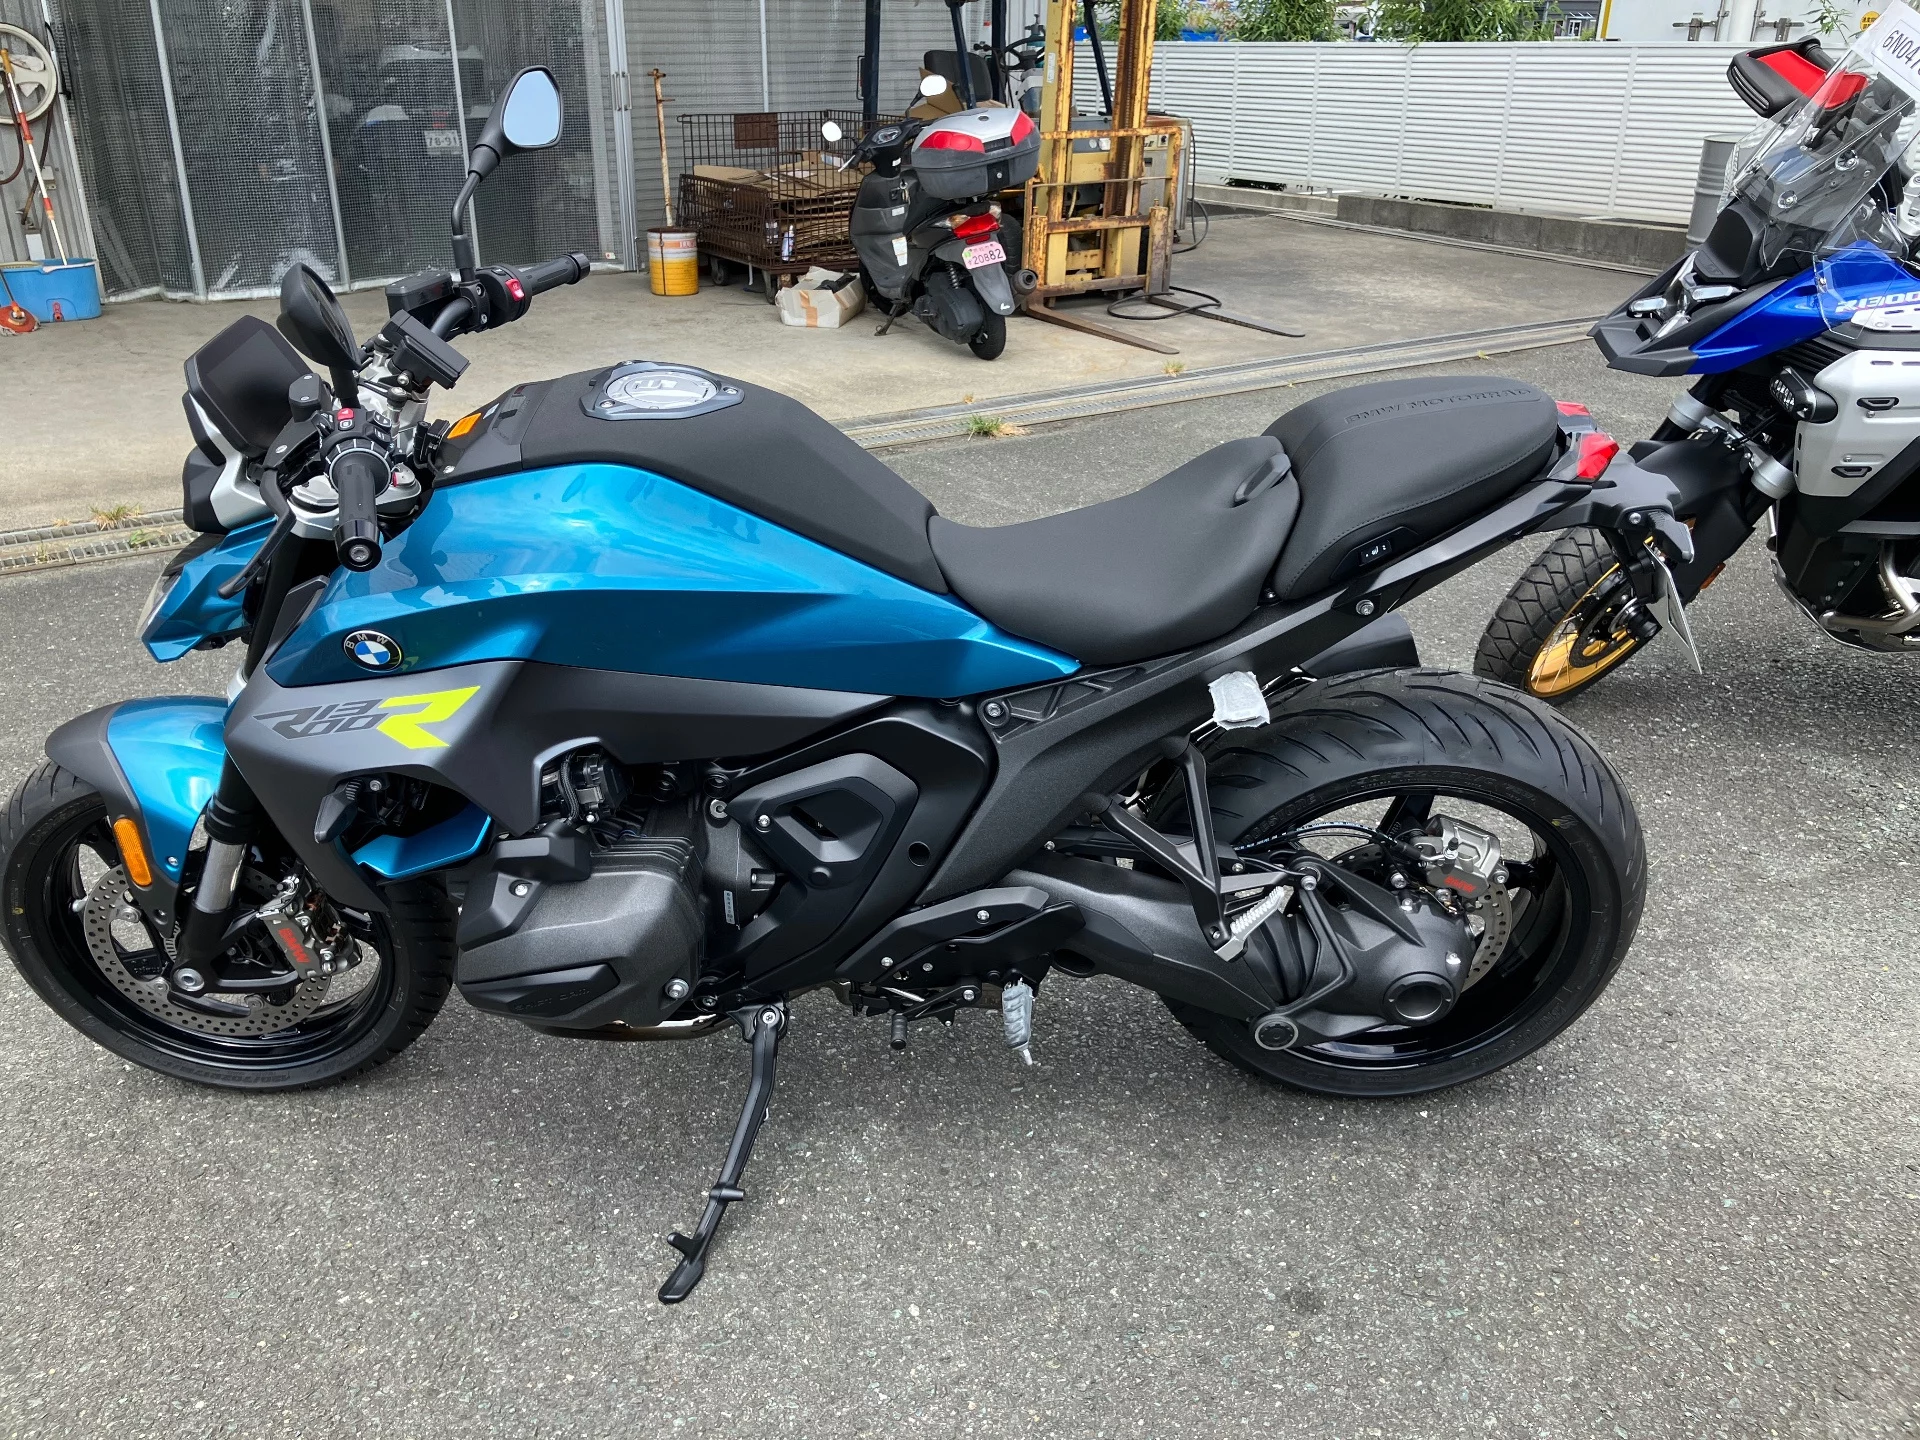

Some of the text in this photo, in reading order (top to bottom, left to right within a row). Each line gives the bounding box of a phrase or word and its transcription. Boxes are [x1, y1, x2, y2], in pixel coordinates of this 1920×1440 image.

[1882, 29, 1920, 76] 6N04
[972, 249, 1004, 265] 20882
[1344, 388, 1531, 425] BMW MOTORRAD
[345, 633, 388, 650] BMW
